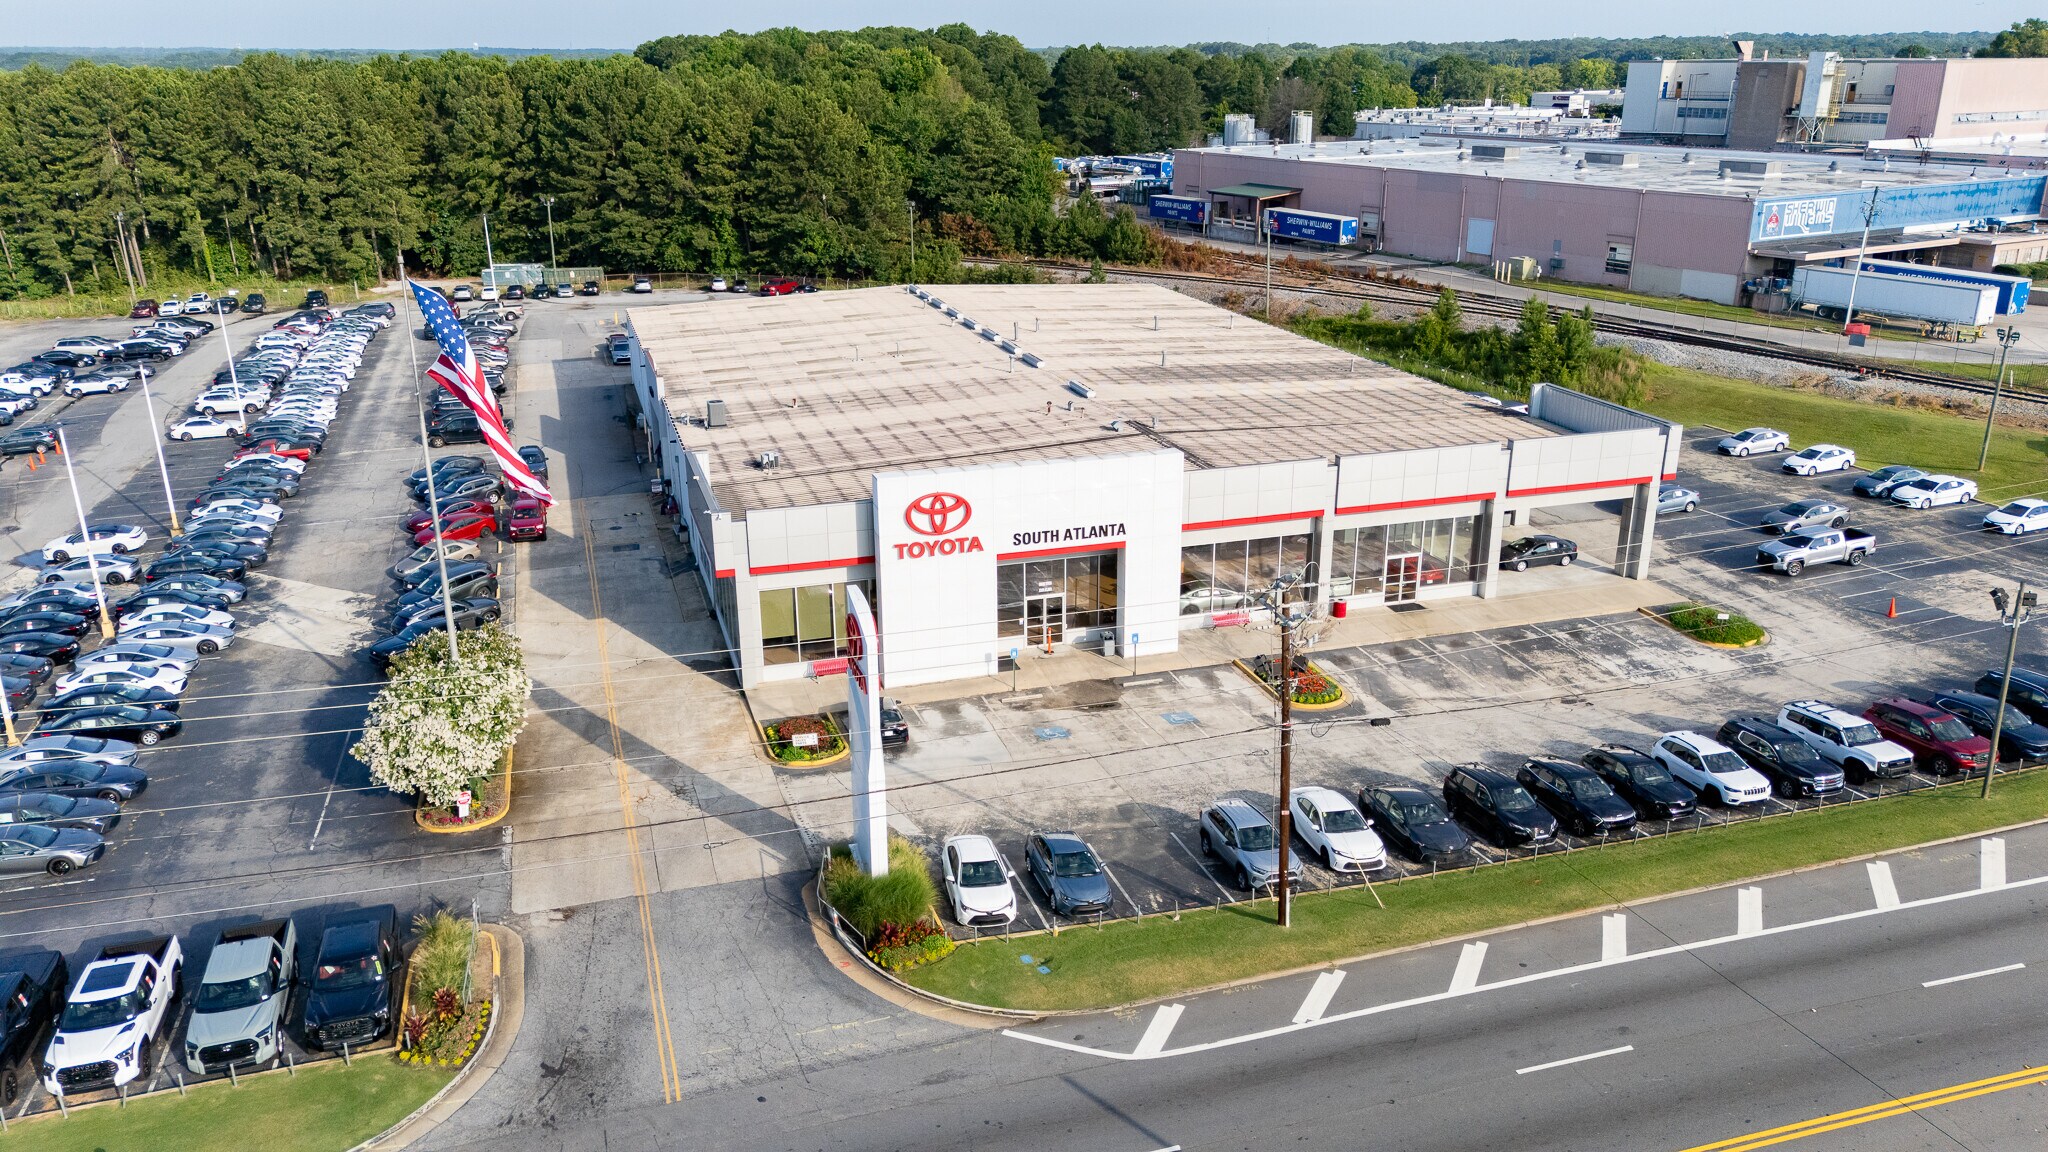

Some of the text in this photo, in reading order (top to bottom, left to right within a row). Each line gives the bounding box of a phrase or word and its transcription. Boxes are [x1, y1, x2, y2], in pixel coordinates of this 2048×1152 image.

[1286, 216, 1333, 230] SHERWIN-WILLIAMS
[1301, 227, 1316, 236] PAINTS
[1013, 523, 1126, 546] SOUTH ATLANTA
[894, 536, 984, 560] TOYOTA
